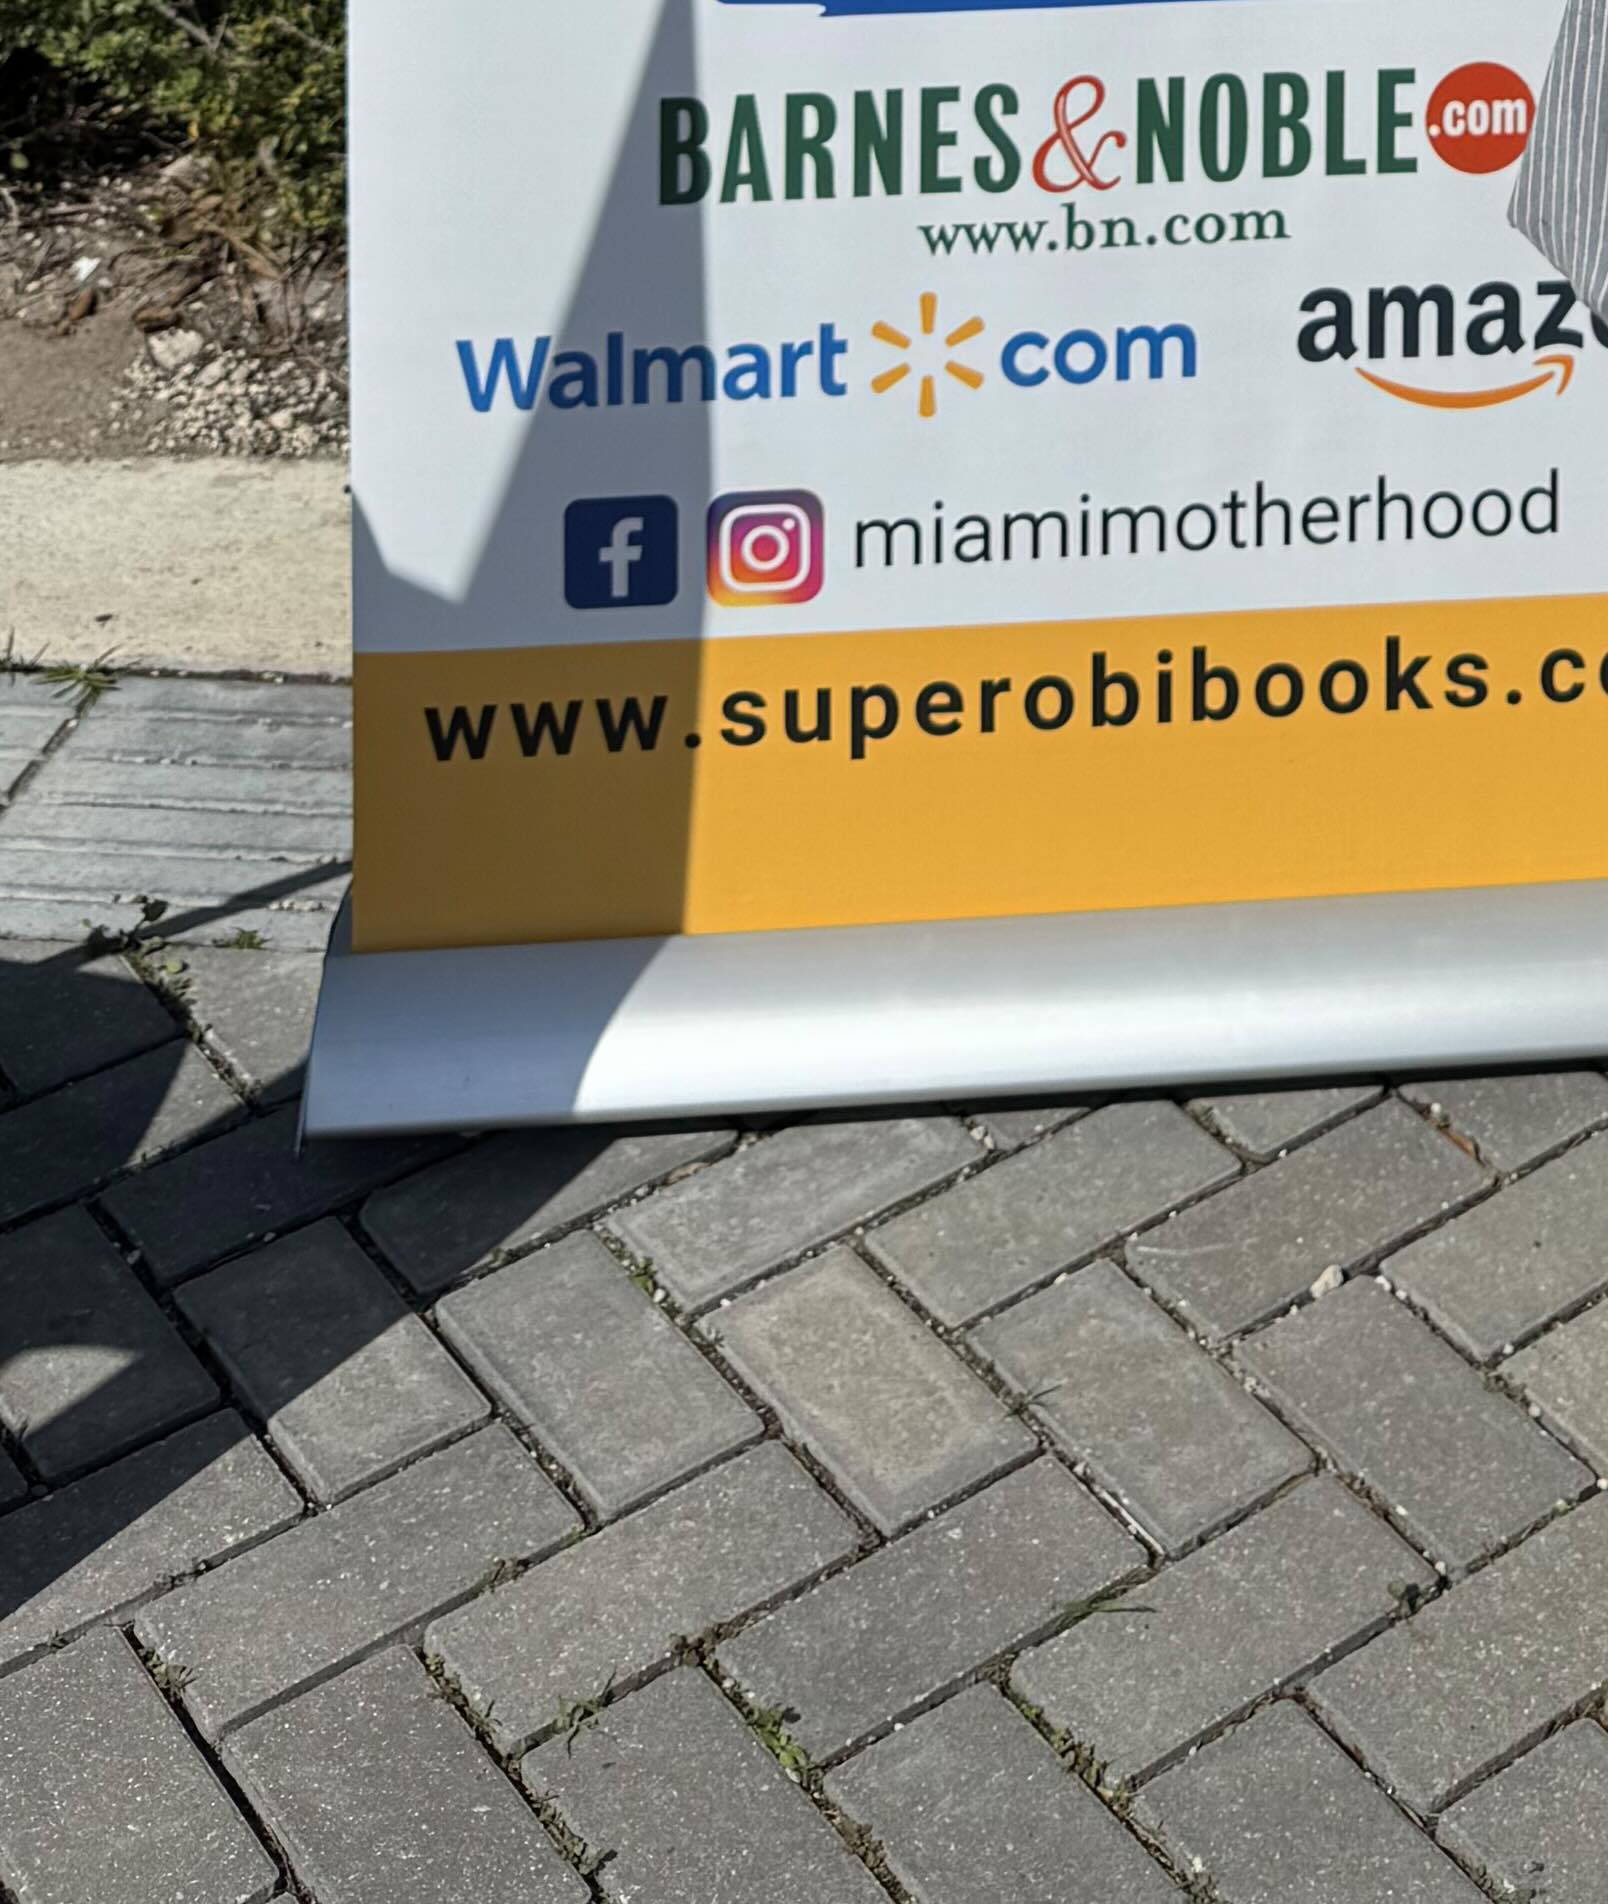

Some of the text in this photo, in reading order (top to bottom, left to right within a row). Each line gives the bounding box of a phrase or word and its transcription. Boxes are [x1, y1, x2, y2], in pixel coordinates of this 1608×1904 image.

[918, 202, 1292, 256] www.bn.com
[455, 318, 1198, 414] Walmart com
[855, 467, 1560, 568] miamimotherhood
